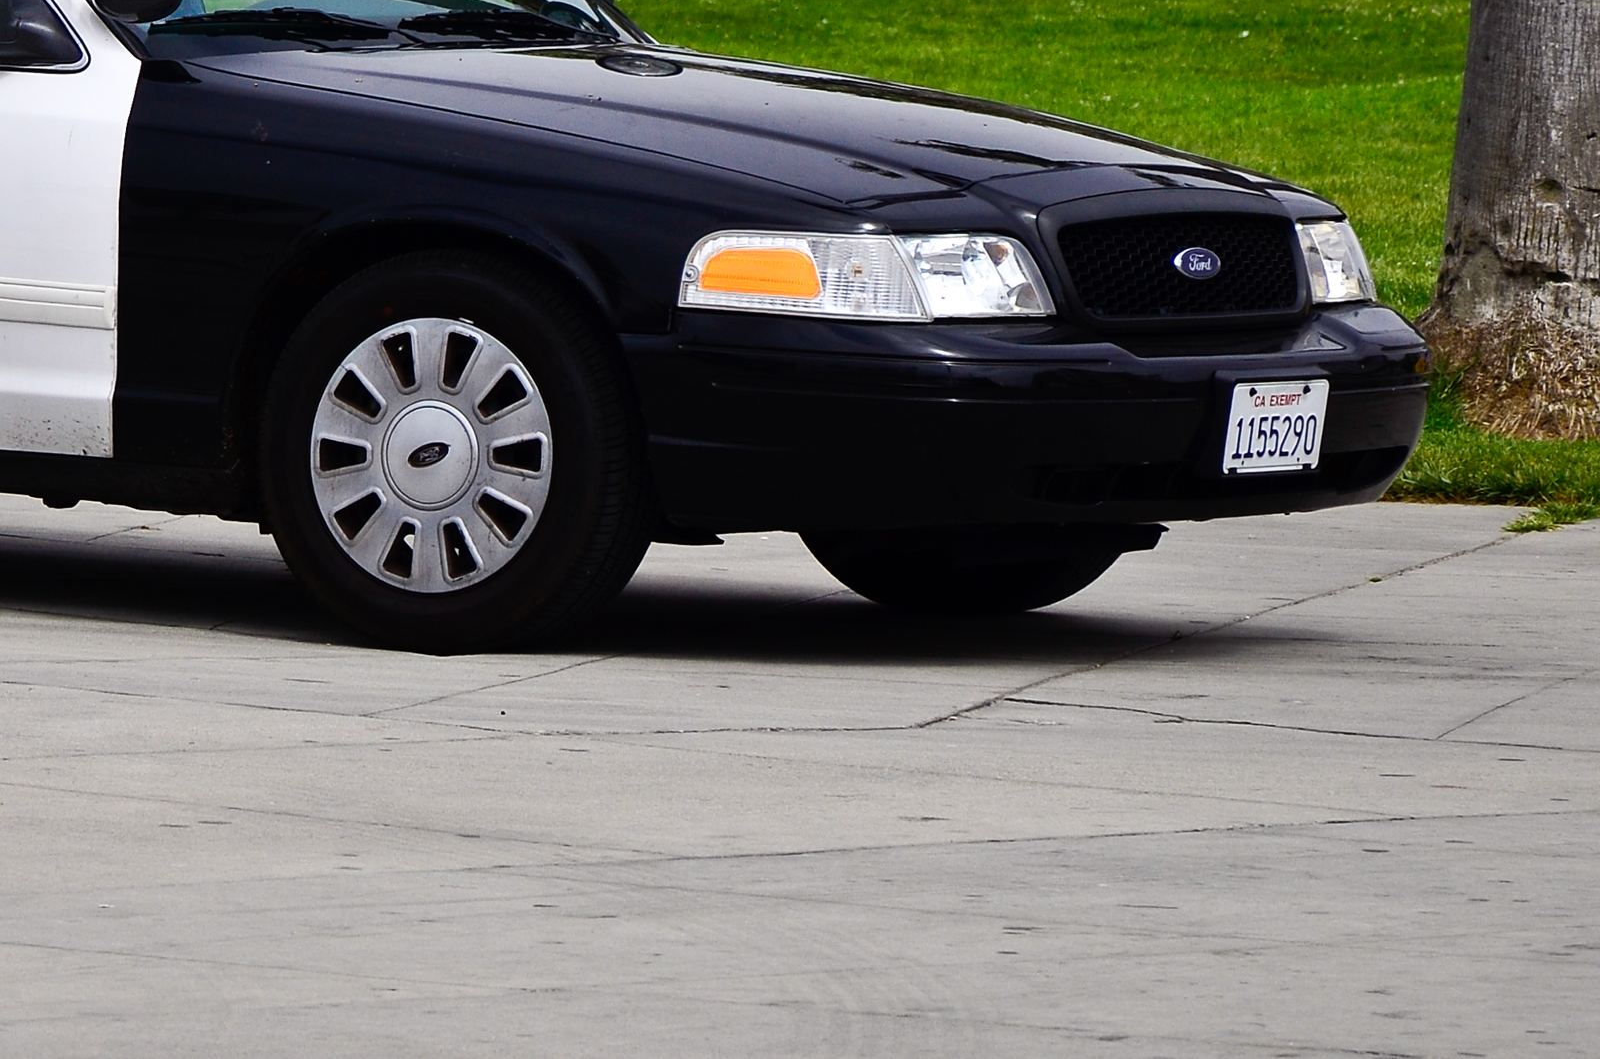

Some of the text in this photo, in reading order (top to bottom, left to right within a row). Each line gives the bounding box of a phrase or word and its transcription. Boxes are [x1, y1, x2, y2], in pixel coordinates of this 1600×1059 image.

[1188, 253, 1212, 272] Ford
[1254, 393, 1302, 408] CA EXEMPT
[1231, 414, 1318, 460] 1155290
